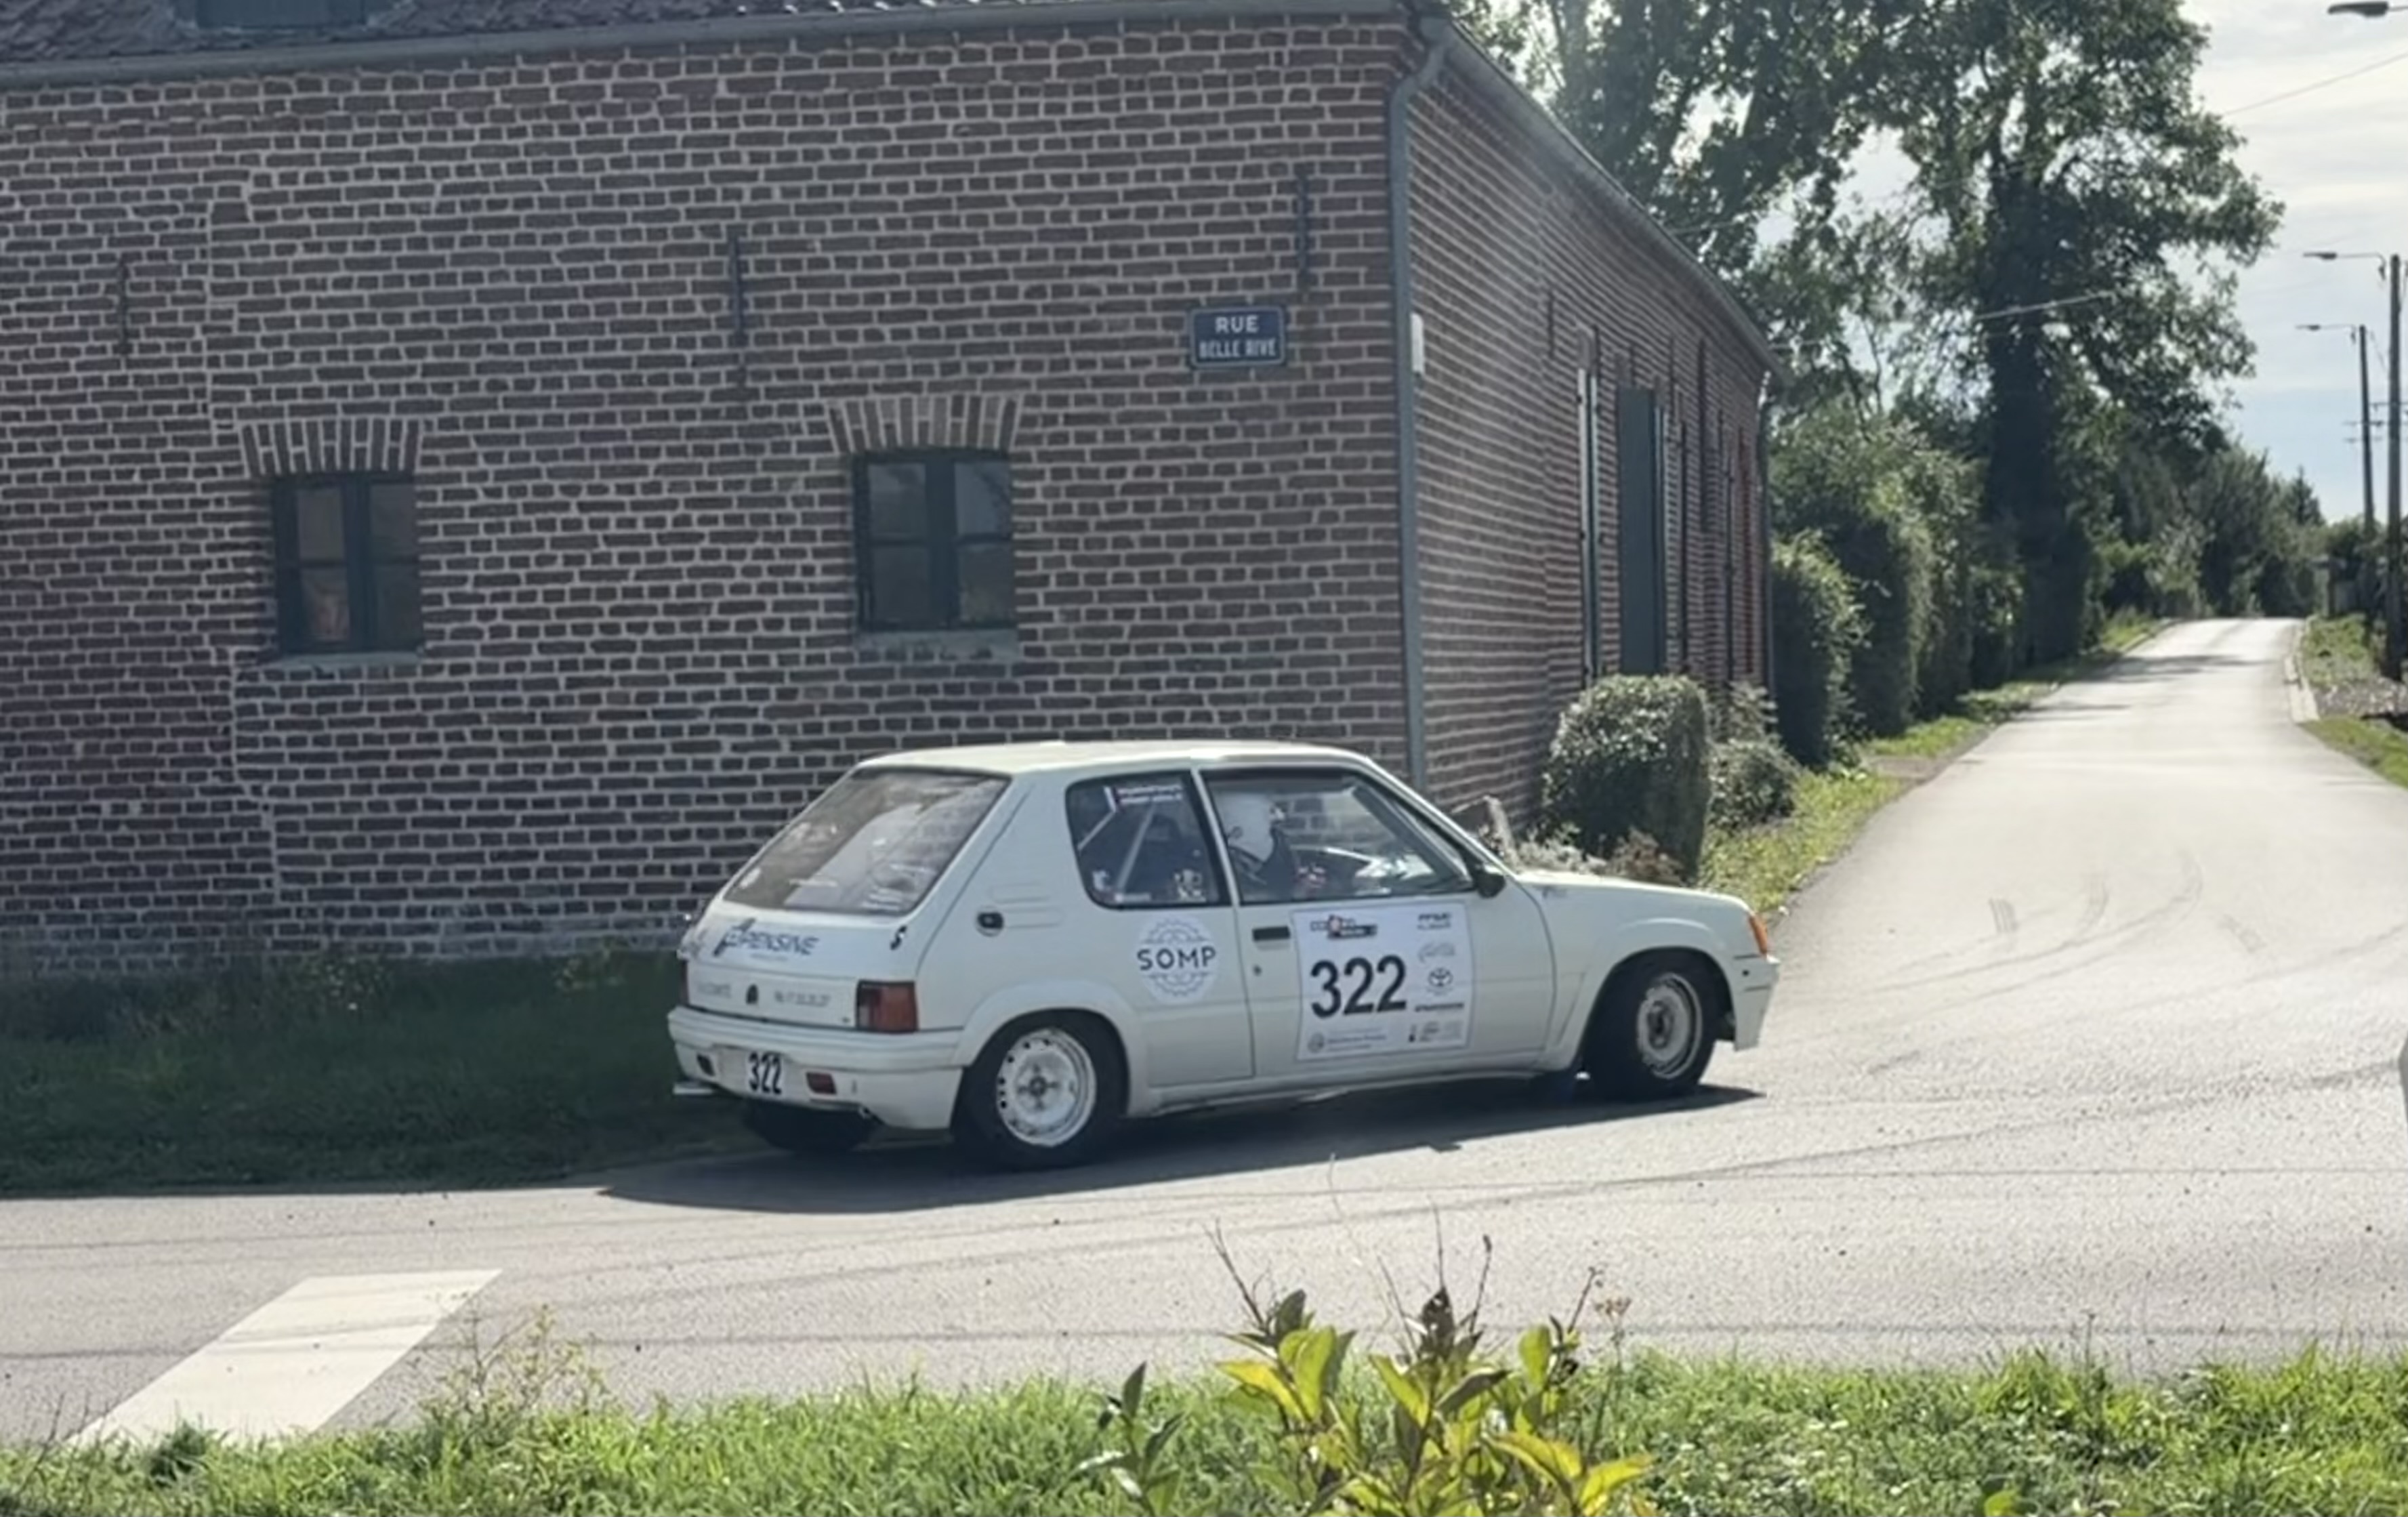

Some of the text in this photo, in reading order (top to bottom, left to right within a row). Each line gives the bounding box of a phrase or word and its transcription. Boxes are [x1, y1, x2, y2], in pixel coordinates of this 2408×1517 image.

[1215, 314, 1259, 333] RUE
[1199, 338, 1276, 358] BELLE RIVE
[1137, 946, 1216, 971] SOMP
[1310, 955, 1407, 1019] 322
[748, 1050, 782, 1094] 322
